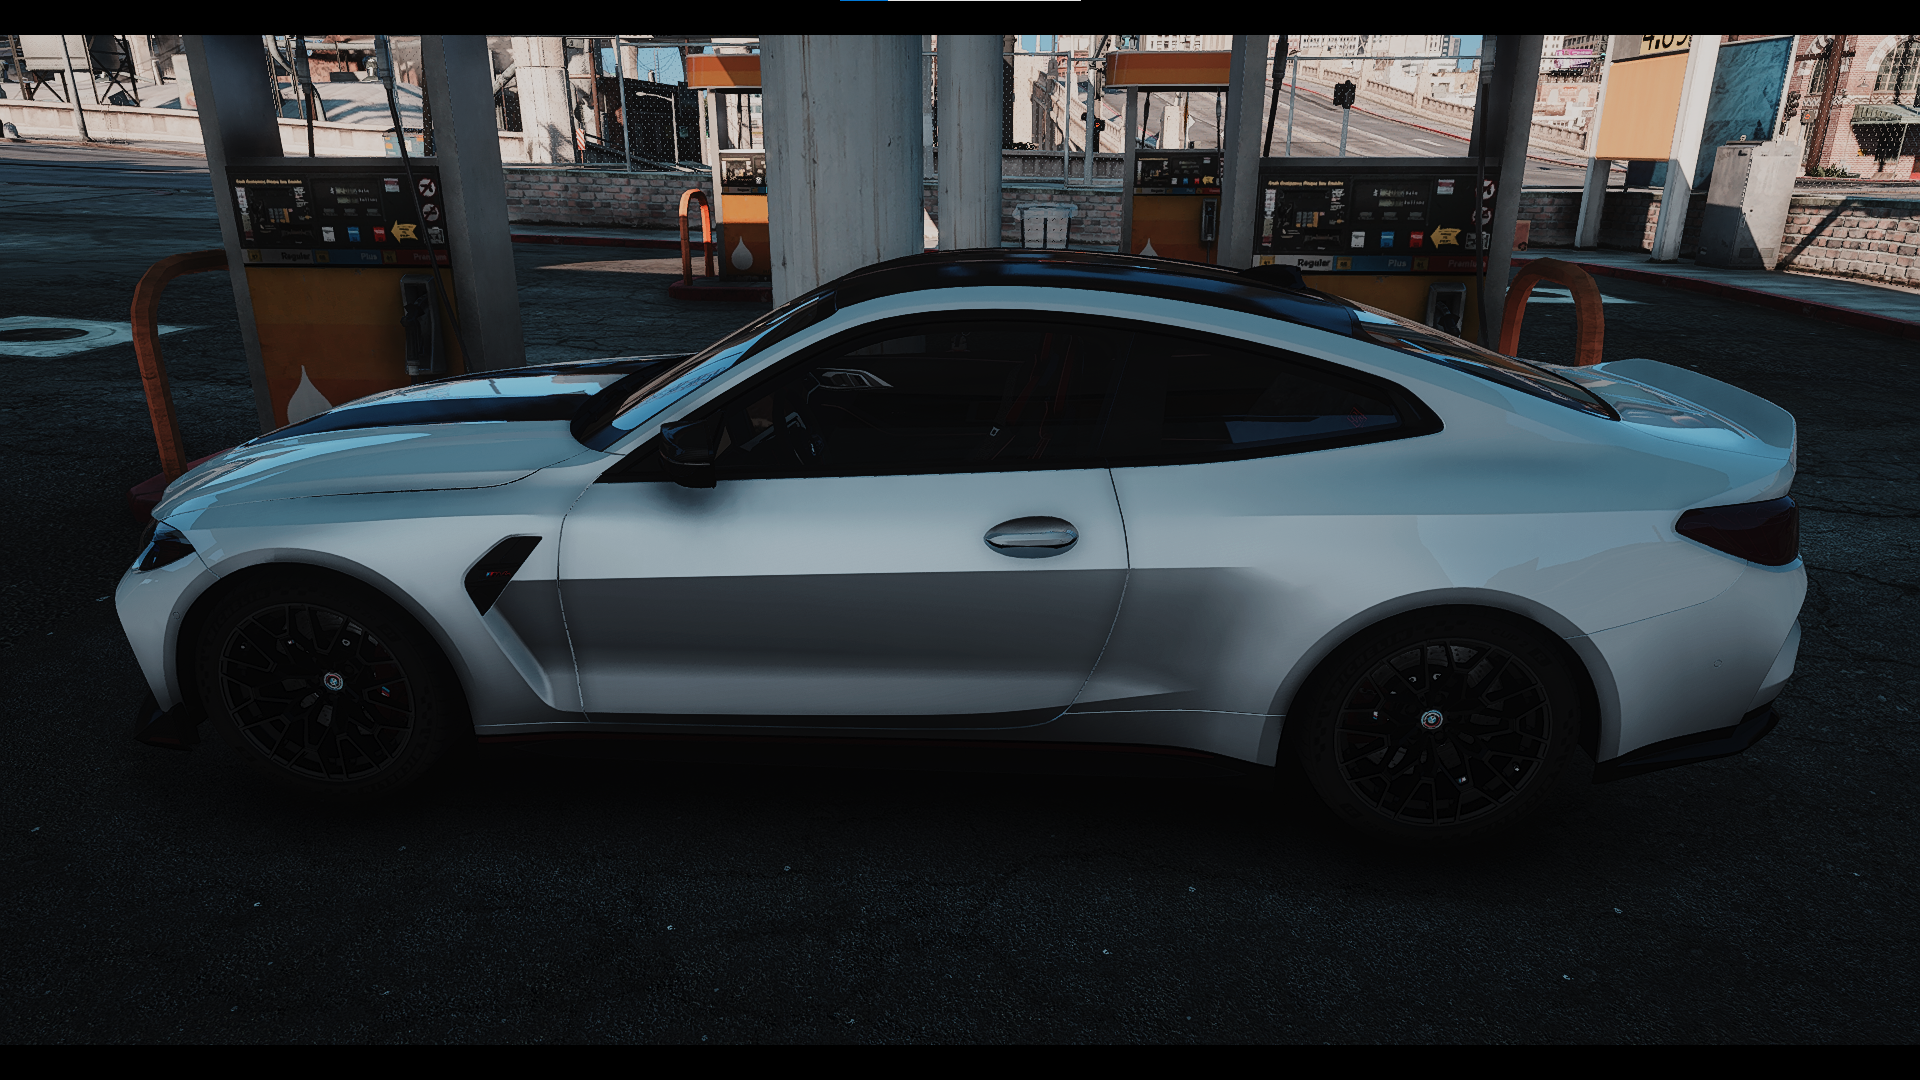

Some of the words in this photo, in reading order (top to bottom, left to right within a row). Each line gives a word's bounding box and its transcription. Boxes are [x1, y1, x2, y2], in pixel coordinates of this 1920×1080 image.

[281, 252, 311, 262] Regular
[360, 253, 377, 261] Plus
[413, 253, 447, 261] Premum
[1297, 259, 1331, 268] Regular
[1387, 259, 1407, 267] Plus
[1490, 627, 1519, 641] CUP
[1518, 640, 1529, 649] 2
[1330, 630, 1408, 697] MICHELIN
